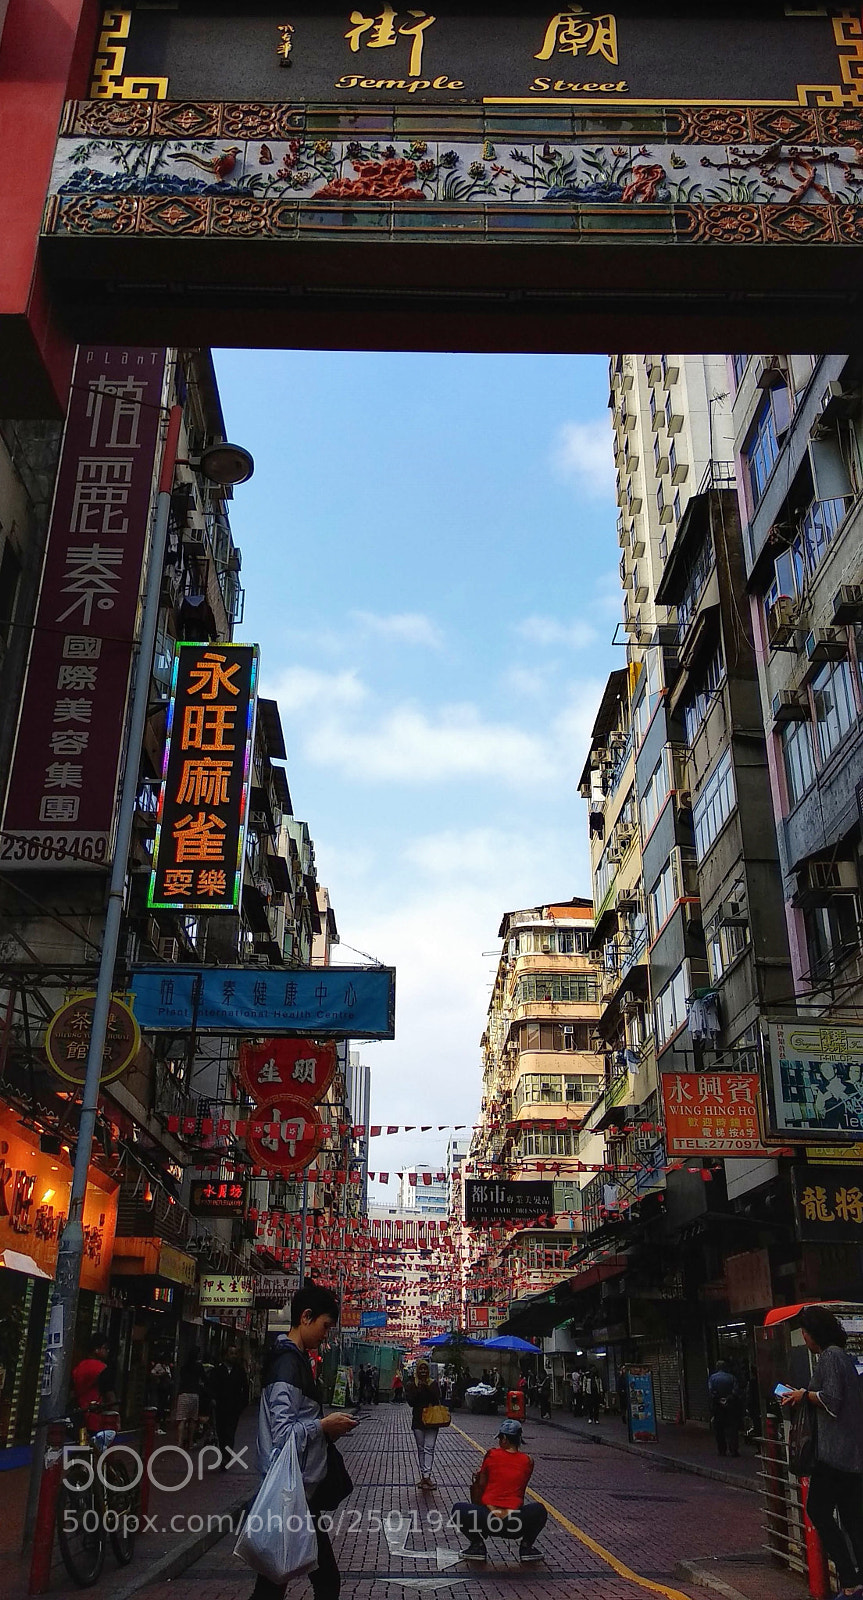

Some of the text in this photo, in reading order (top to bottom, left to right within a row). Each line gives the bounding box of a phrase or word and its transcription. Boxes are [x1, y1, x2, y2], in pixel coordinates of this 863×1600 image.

[335, 75, 629, 93] Temple Street
[158, 1007, 355, 1019] Plant nternational Health Centre
[669, 1105, 701, 1115] WING
[704, 1105, 735, 1116] HING
